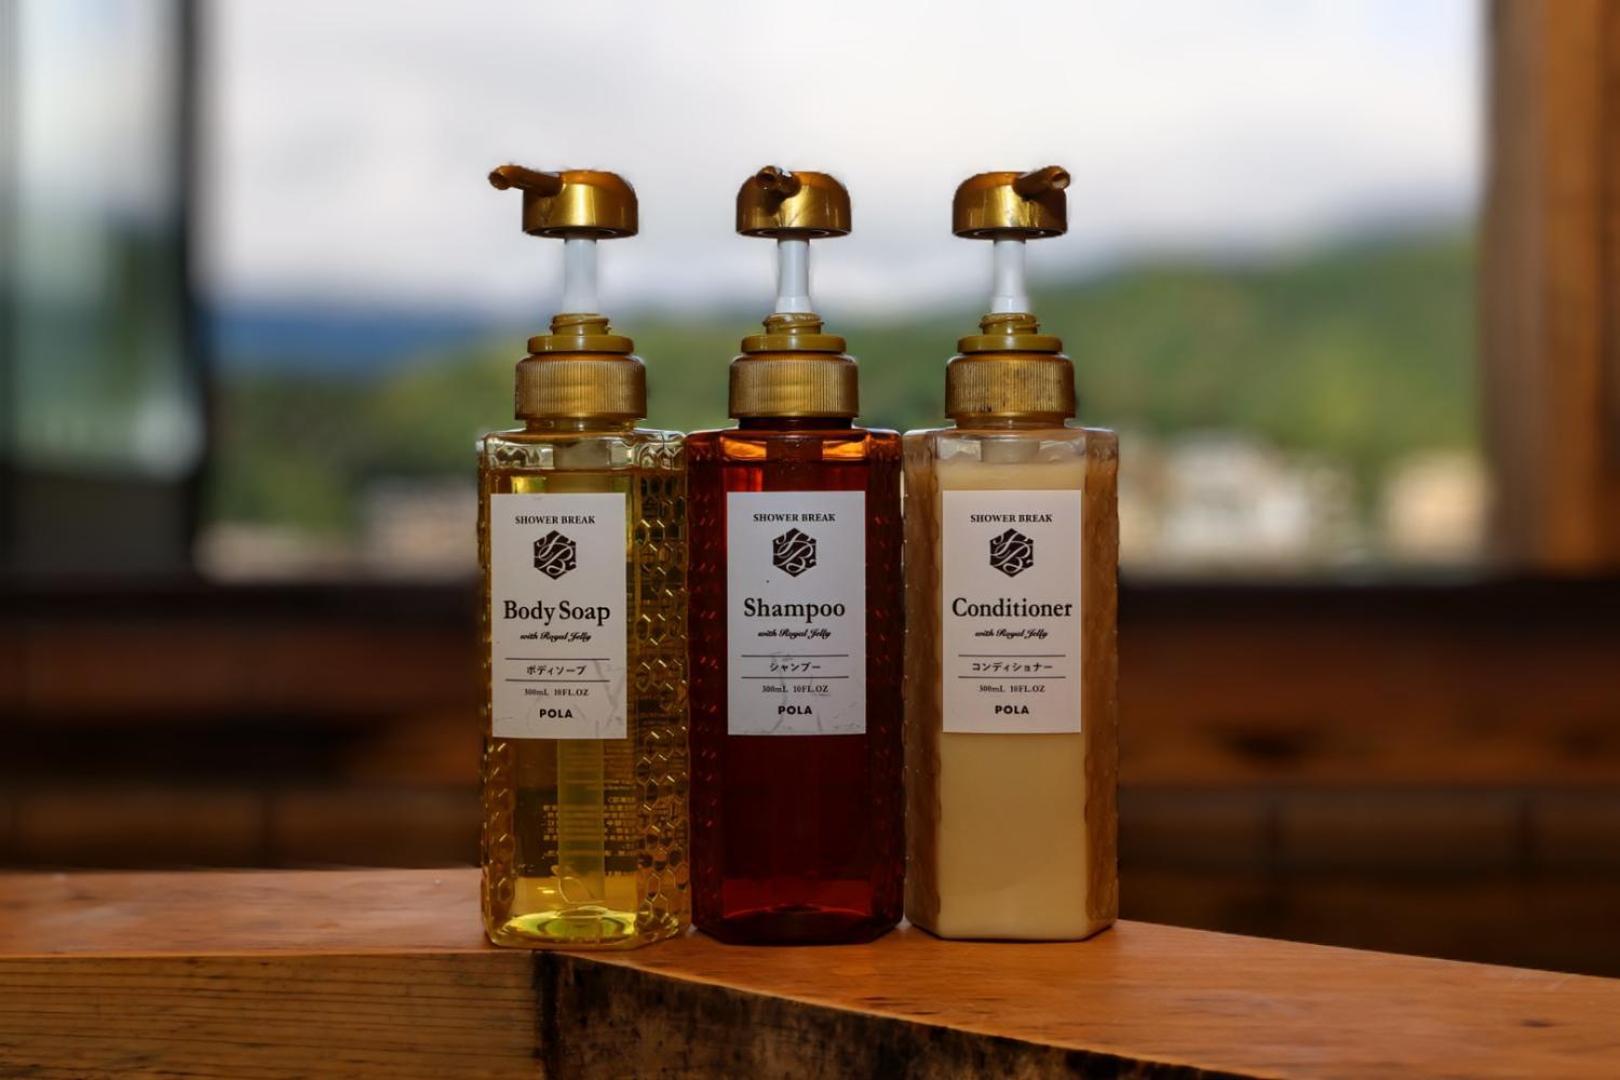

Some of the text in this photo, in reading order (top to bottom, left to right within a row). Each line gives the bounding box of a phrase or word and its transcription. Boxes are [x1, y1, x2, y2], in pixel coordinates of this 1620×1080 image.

[515, 515, 596, 525] SHOWER BREAK
[753, 513, 836, 523] SHOWER BREAK
[970, 513, 1053, 523] SHOWER BREAK
[743, 597, 846, 624] Shampoo
[951, 597, 1073, 618] Conditioner
[503, 600, 611, 627] Body Soap
[520, 632, 592, 643] with Royal Jelly
[757, 629, 832, 640] with Royal Jelly
[974, 629, 1049, 640] with Royal Jelly
[526, 665, 587, 676] ボディソープ
[769, 661, 821, 672] シャンプー
[970, 661, 1053, 673] コンディショナー
[539, 708, 574, 719] POLA
[778, 705, 813, 716] POLA
[994, 704, 1030, 715] POLA
